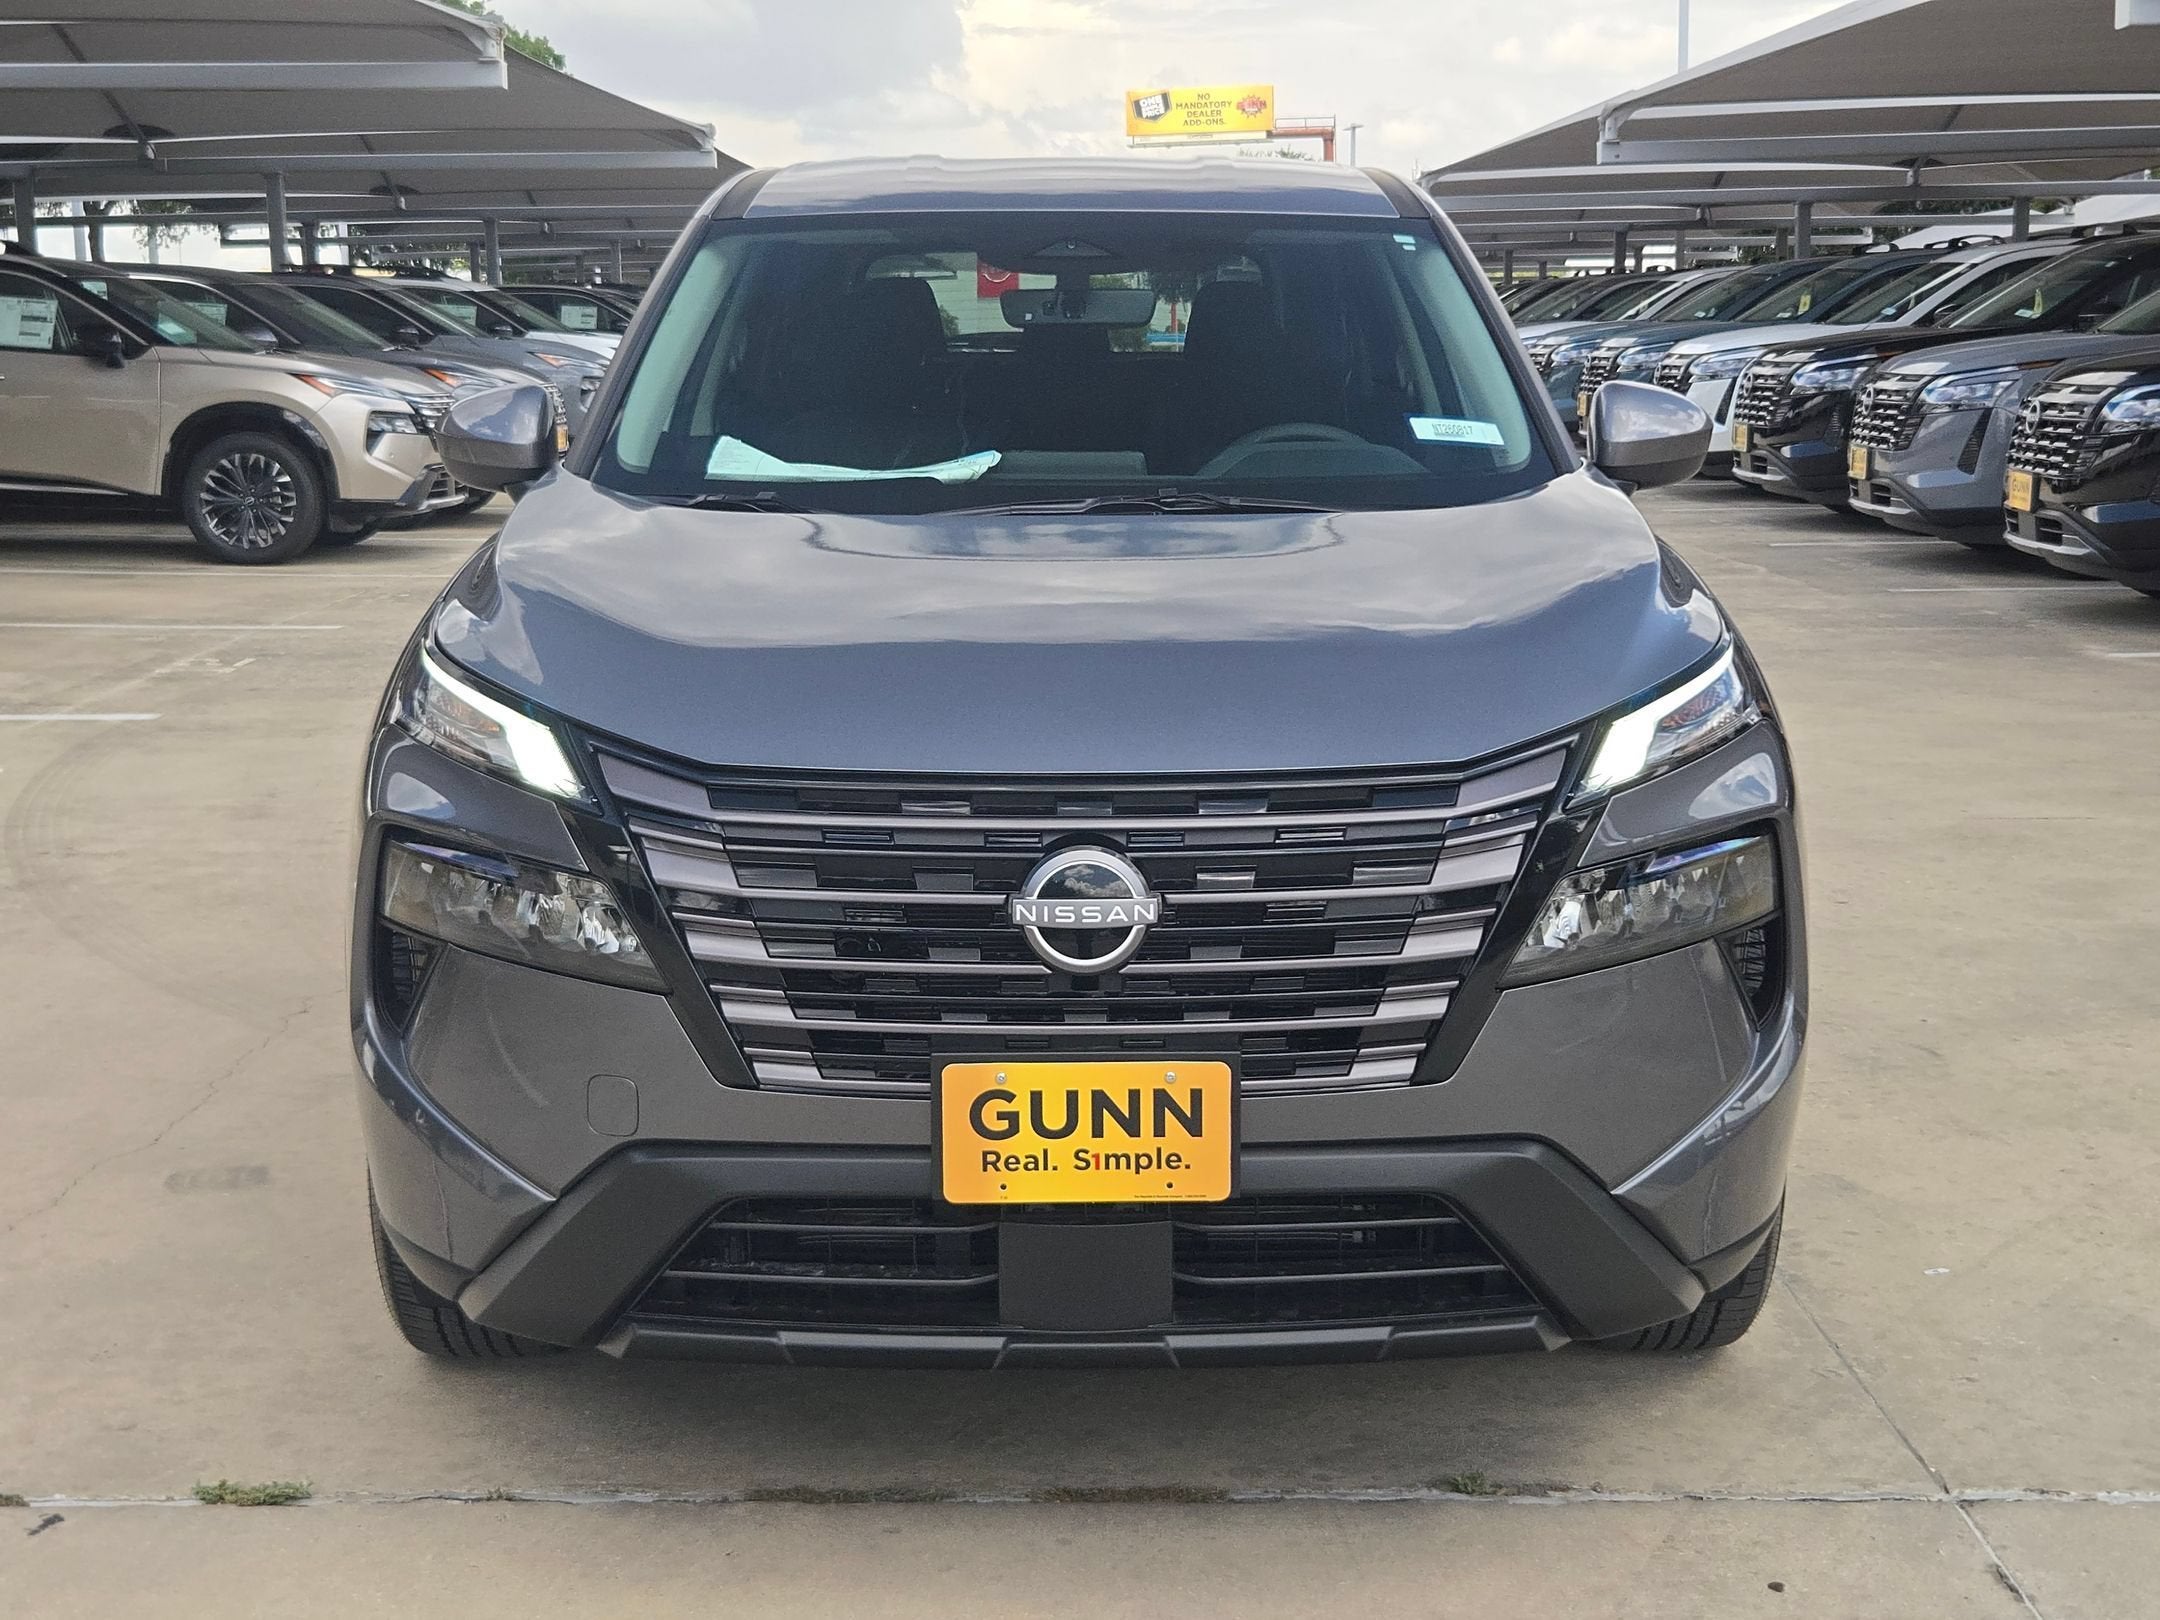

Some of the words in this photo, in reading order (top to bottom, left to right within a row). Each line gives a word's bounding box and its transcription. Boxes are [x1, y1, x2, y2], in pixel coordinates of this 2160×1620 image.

[1176, 101, 1232, 110] MANDATORY
[1187, 110, 1221, 118] DEALER
[1015, 904, 1154, 923] NISSAN
[969, 1088, 1203, 1141] GUNN
[981, 1149, 1058, 1172] Real.
[1073, 1147, 1191, 1175] S1mple.
